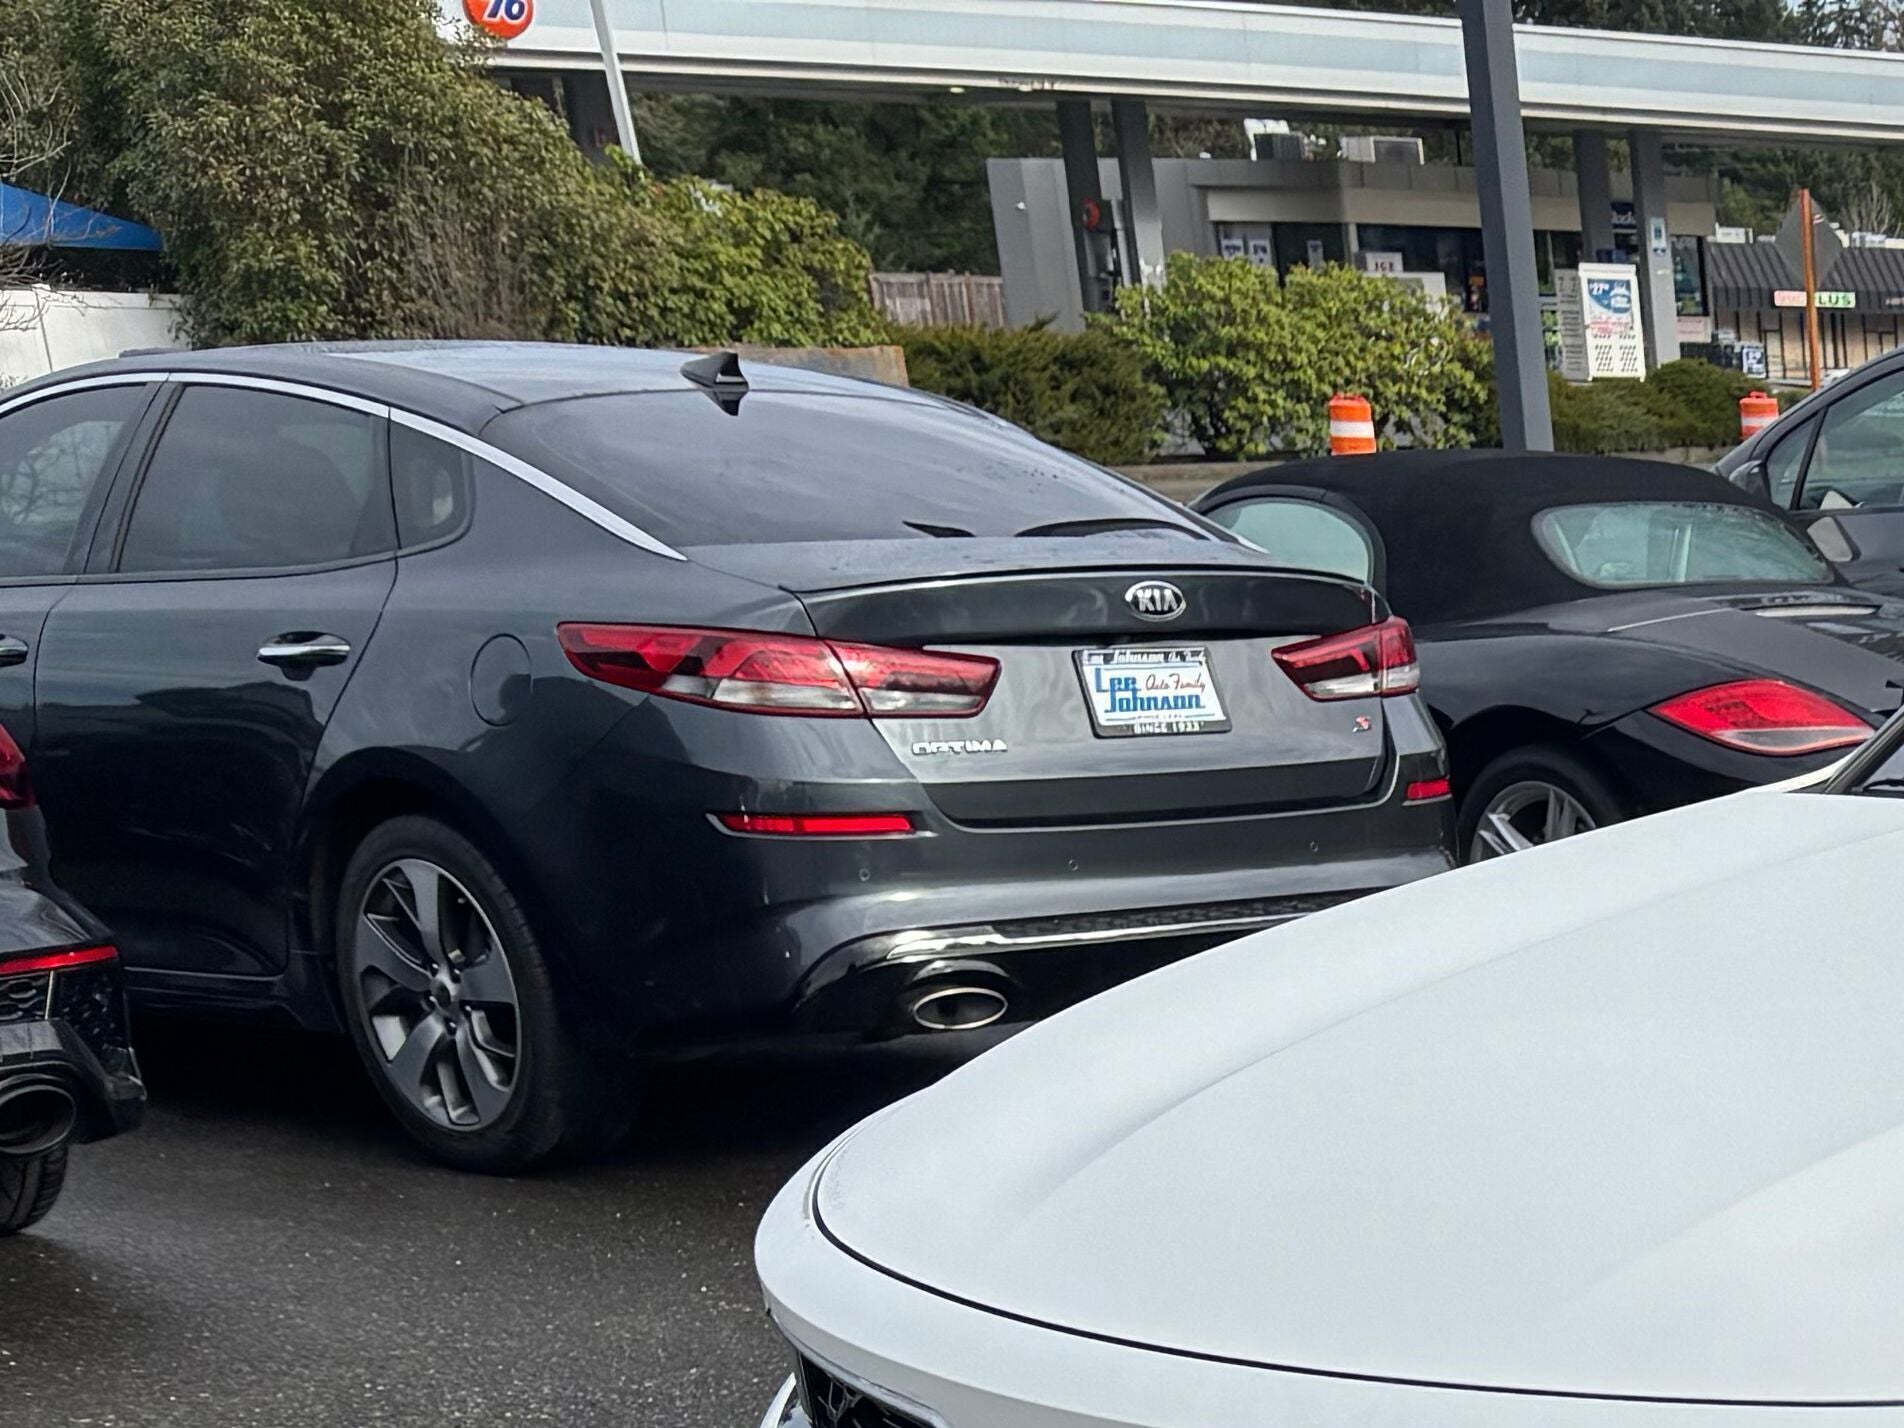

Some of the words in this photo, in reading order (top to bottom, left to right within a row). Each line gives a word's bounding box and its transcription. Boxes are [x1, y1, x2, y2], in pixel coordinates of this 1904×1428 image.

[1095, 667, 1142, 693] Lee
[1104, 686, 1206, 713] Johnson
[911, 738, 1008, 755] OPTIMA
